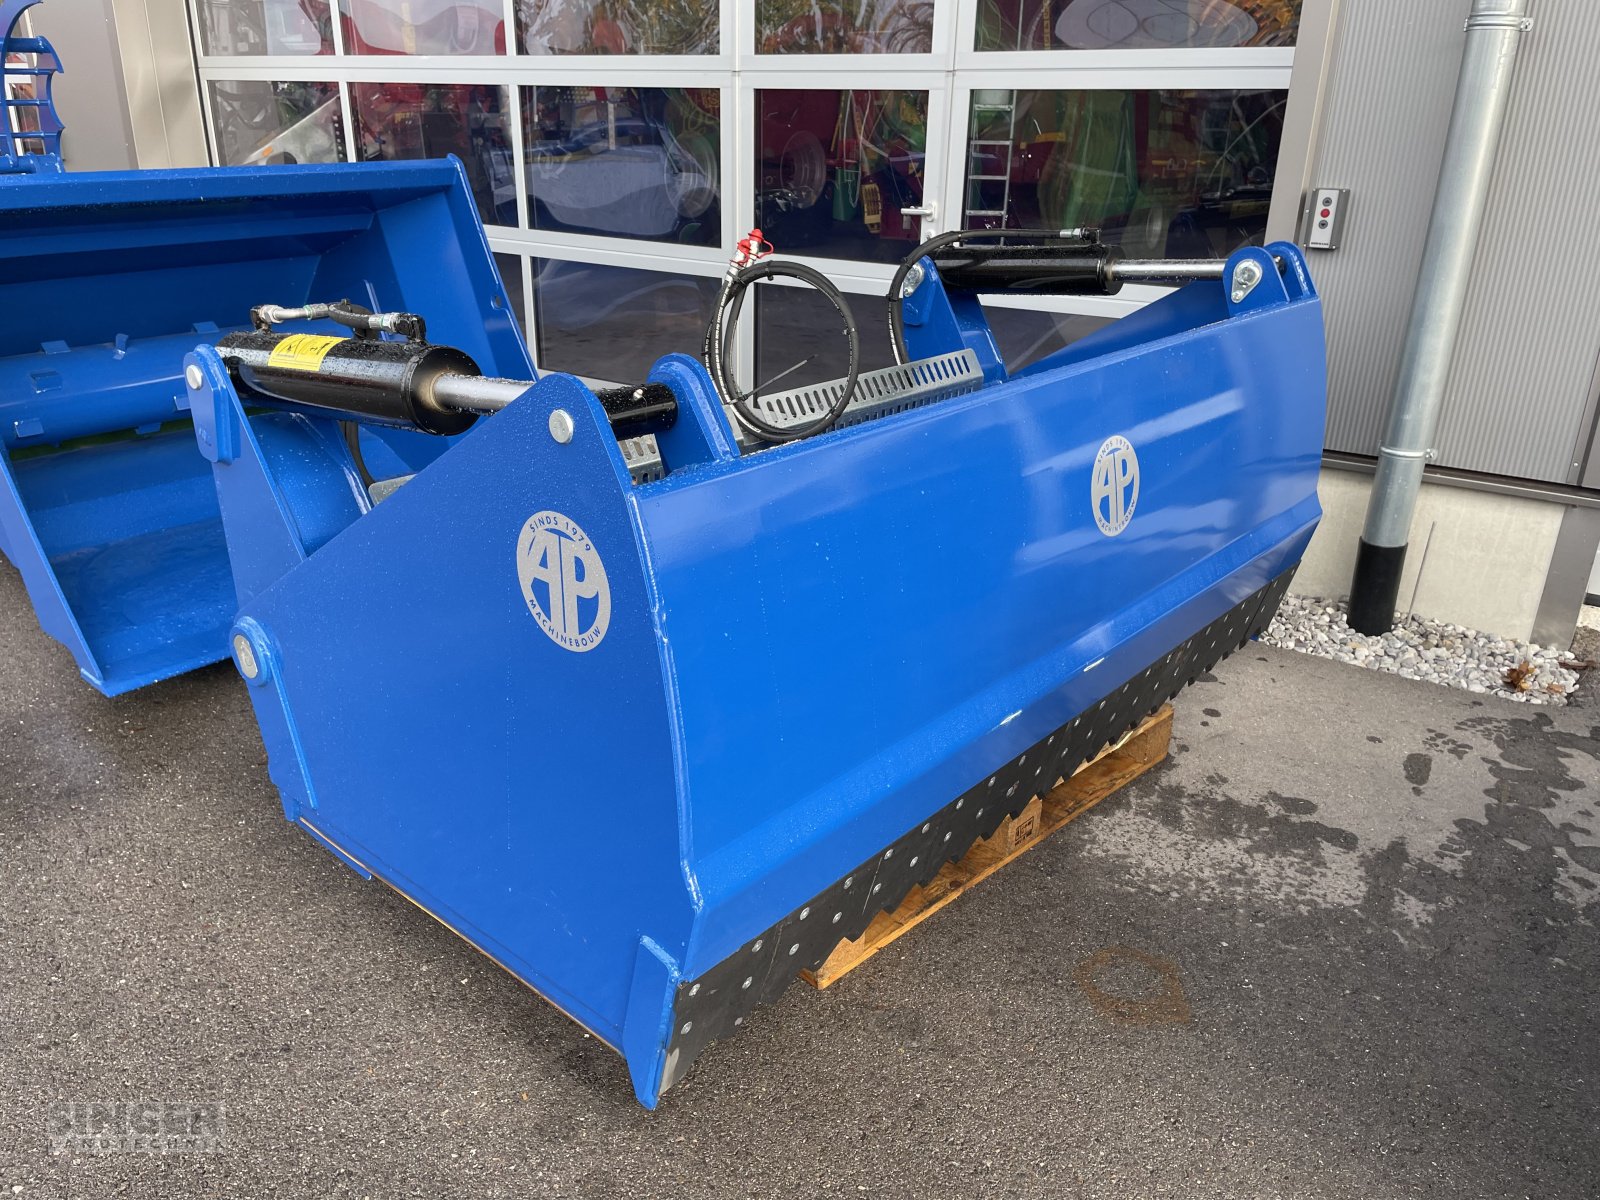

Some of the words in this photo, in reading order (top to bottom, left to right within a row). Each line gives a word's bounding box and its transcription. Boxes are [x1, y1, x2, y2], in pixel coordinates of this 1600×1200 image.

[529, 515, 558, 533] SINDS
[564, 521, 591, 552] 1979
[528, 599, 602, 648] MACHINEBOUW
